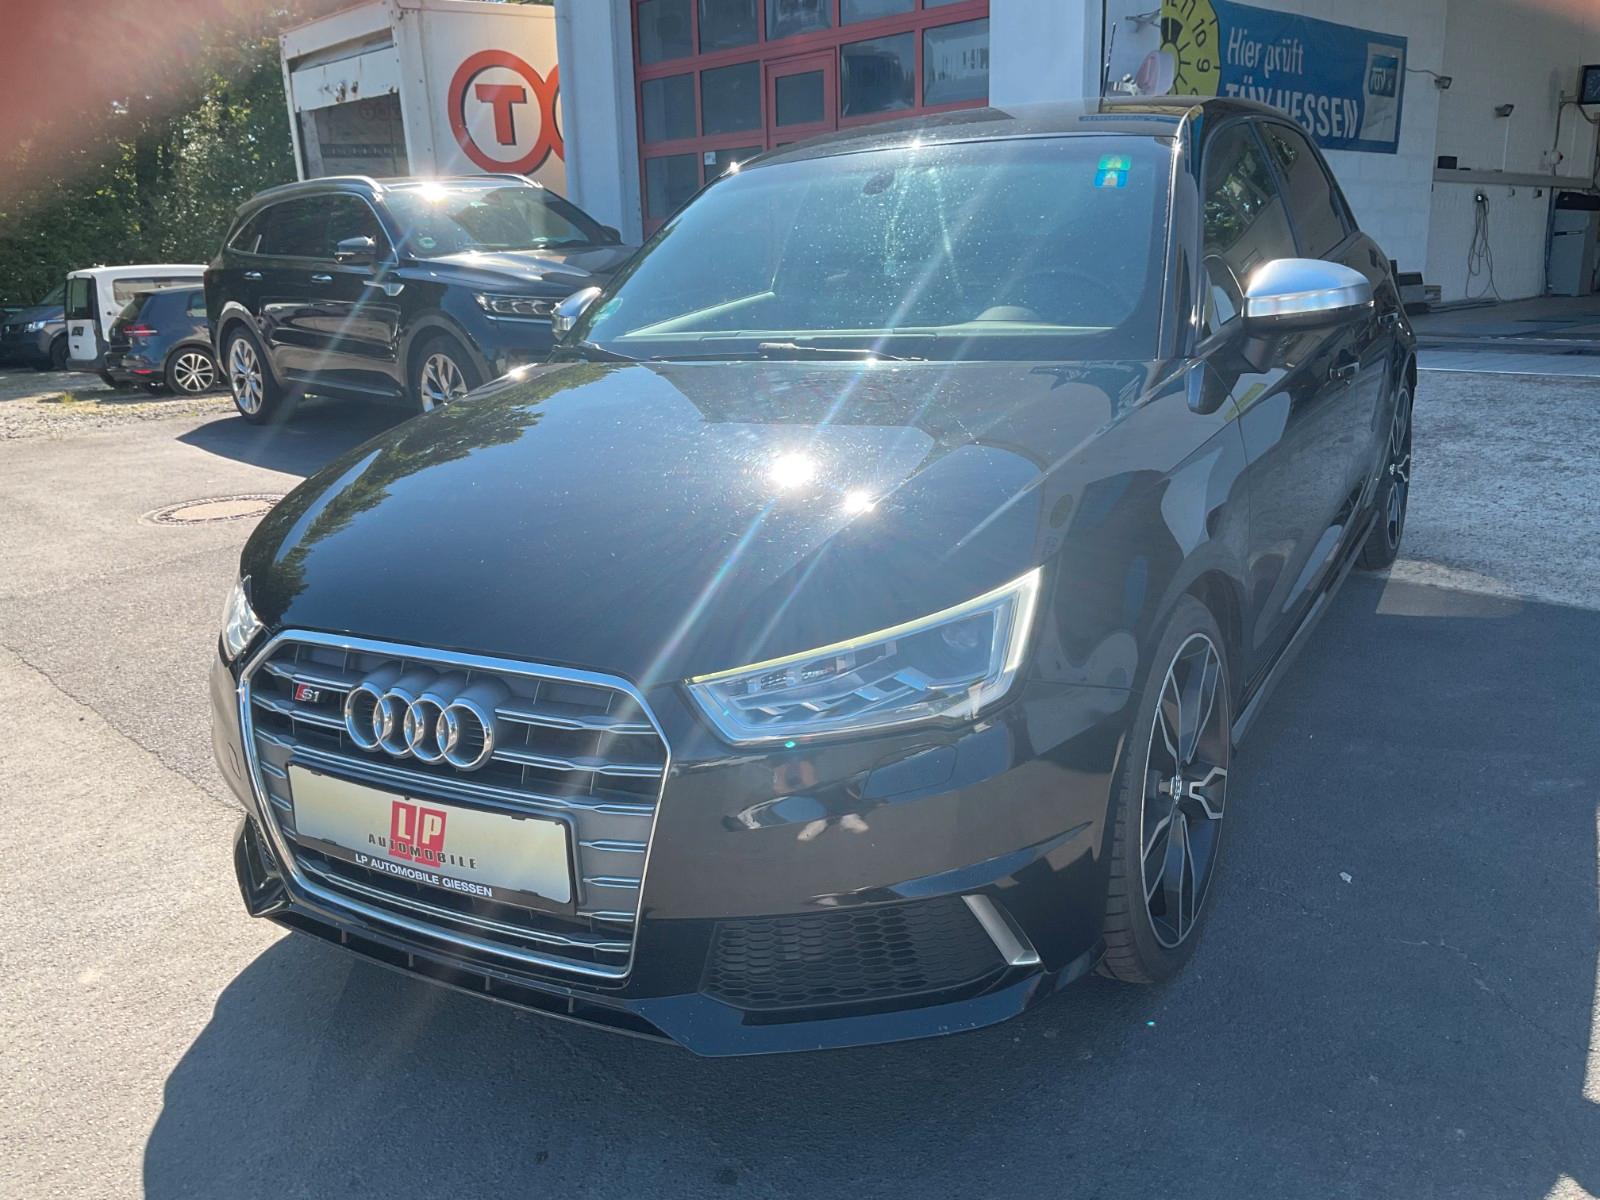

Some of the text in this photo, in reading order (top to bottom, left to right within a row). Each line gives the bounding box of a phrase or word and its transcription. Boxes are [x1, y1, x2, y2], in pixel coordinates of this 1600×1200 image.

[1192, 18, 1206, 48] 10
[1227, 26, 1303, 79] Hier prüft
[302, 688, 320, 702] S1
[397, 807, 442, 845] LP
[368, 833, 478, 869] AUTOMOBILE
[355, 853, 493, 897] LP AUTOMOBILE GIESSEN
